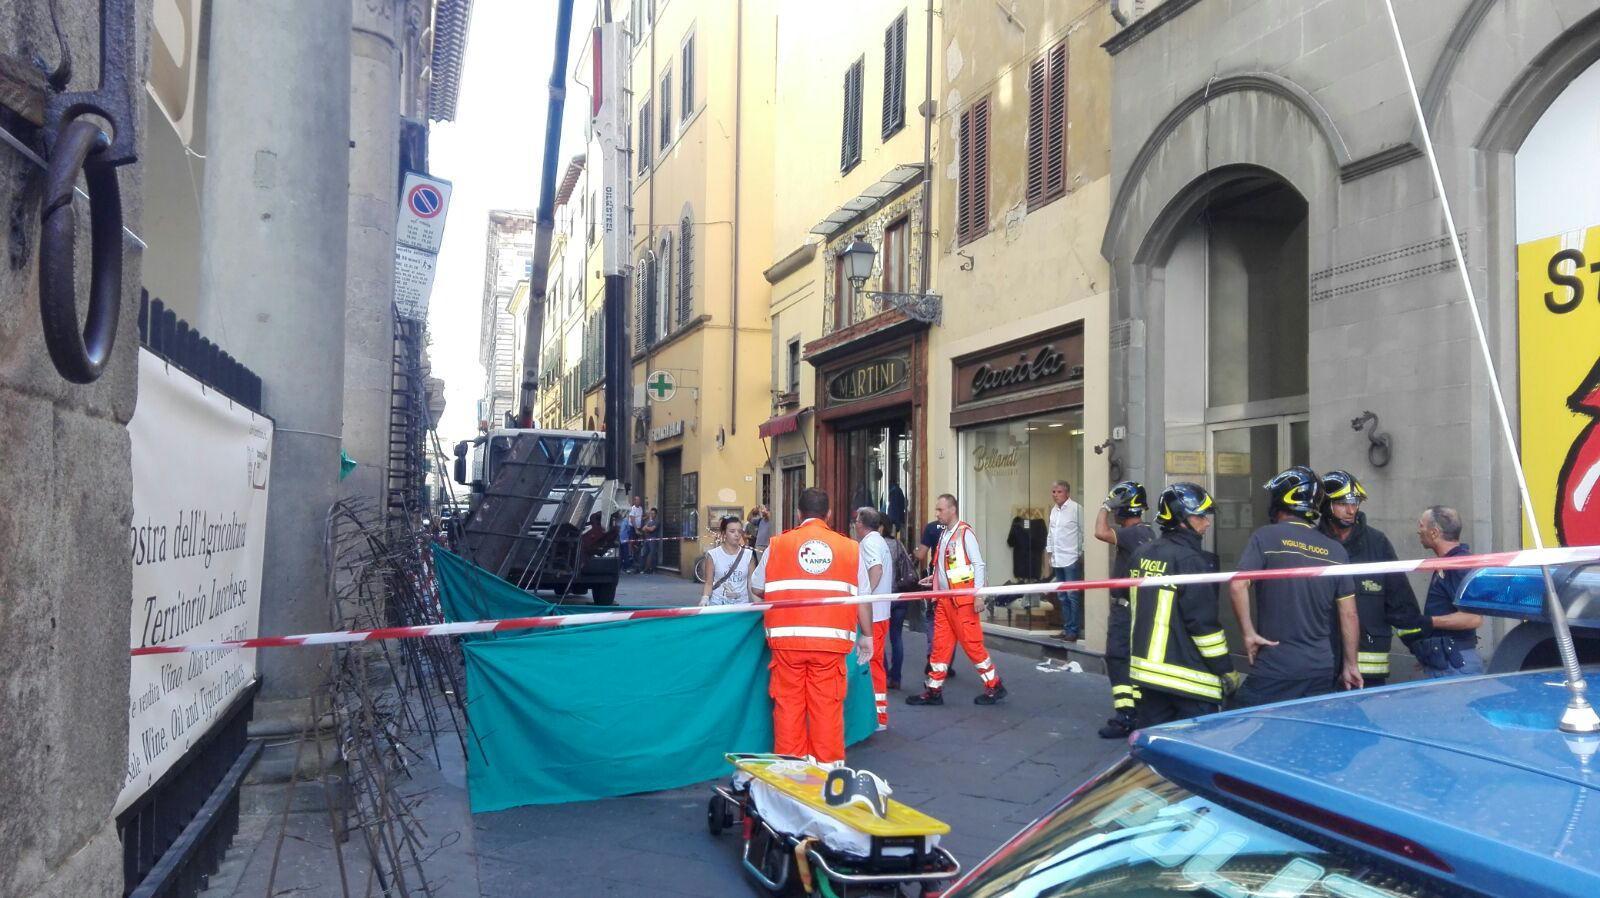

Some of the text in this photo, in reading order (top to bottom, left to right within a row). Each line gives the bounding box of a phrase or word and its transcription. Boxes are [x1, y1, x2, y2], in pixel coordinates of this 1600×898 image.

[839, 362, 894, 398] MARTINI
[141, 573, 247, 648] Territorio Lucchese
[138, 683, 160, 713] vendita
[171, 704, 184, 741] Oil
[186, 692, 199, 729] and
[200, 674, 223, 722] Typical
